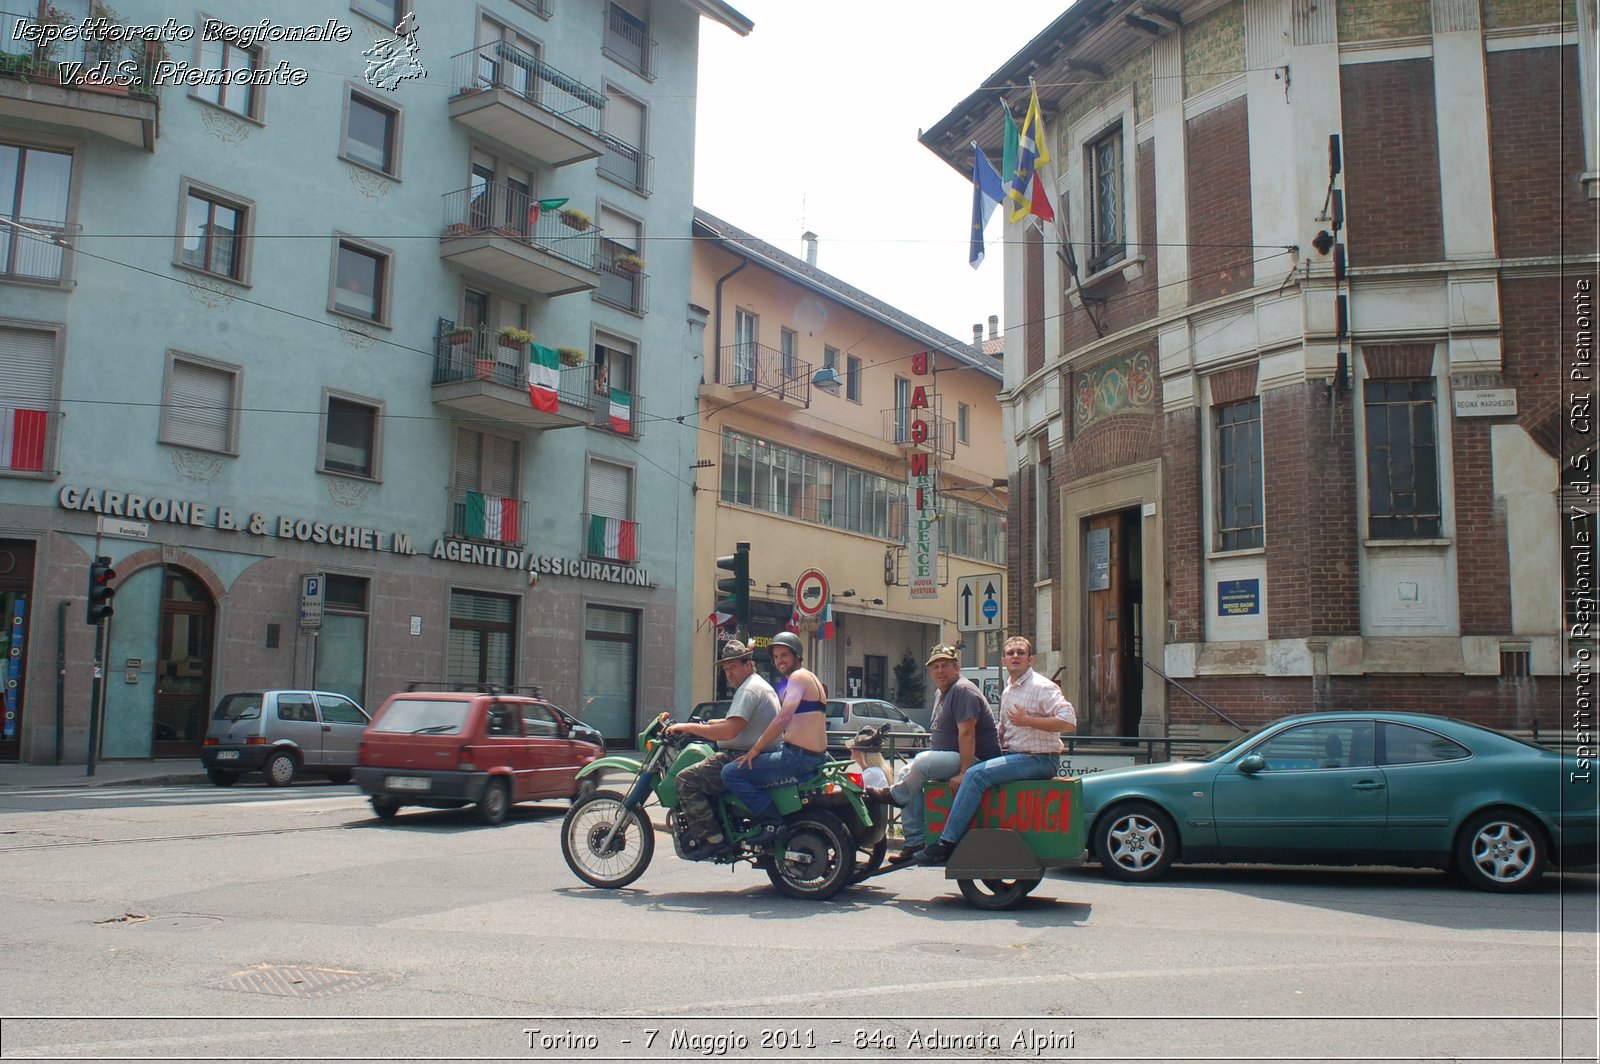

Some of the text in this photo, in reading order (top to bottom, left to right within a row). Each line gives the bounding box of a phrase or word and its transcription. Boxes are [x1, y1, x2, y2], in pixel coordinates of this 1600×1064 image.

[1480, 399, 1515, 408] MARGHERITA
[59, 485, 652, 588] GARRONE B. & BOSCHET M. AGENTI DI ASSICURAZIONI
[119, 526, 146, 537] Vanchiglia
[910, 587, 936, 595] APERTURA
